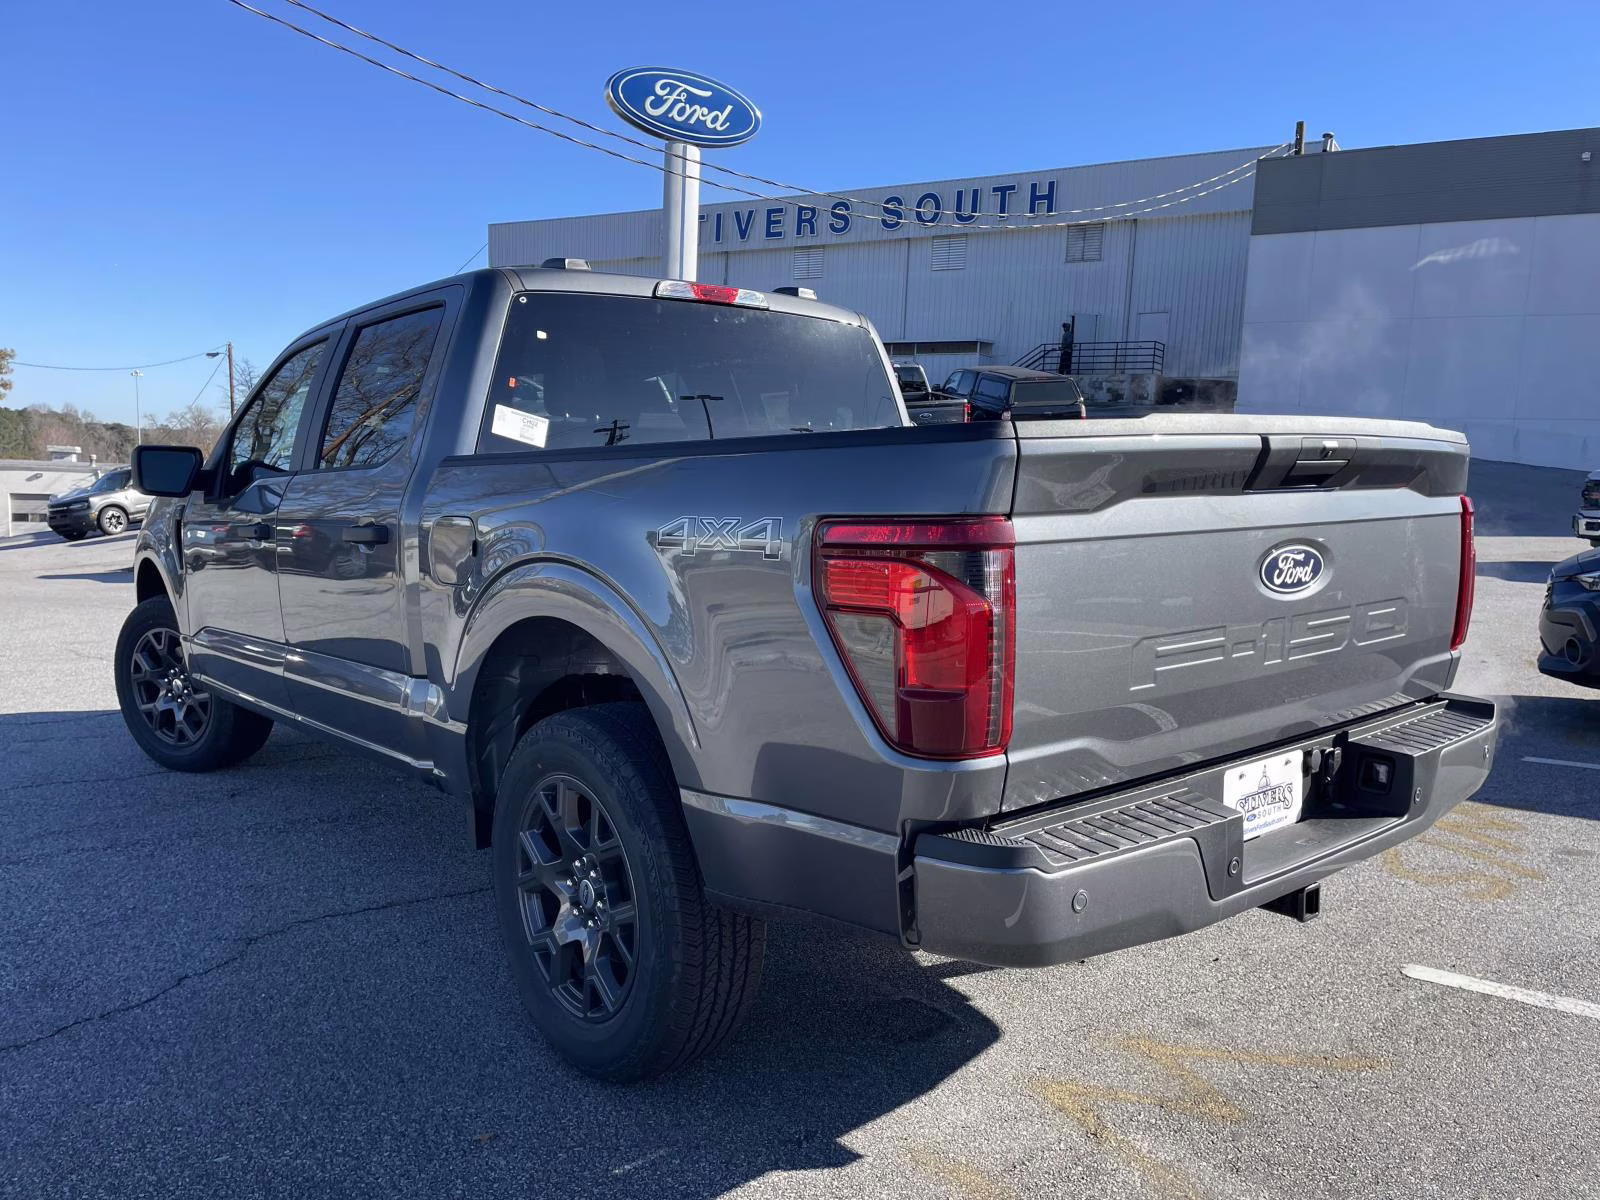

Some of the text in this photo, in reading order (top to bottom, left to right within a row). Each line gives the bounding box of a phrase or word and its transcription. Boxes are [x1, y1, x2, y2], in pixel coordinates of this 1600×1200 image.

[644, 79, 733, 131] Ford
[880, 179, 1057, 231] SOUTH
[1273, 552, 1314, 585] Ford
[1129, 596, 1409, 690] F-150
[1257, 805, 1282, 820] SOUTH
